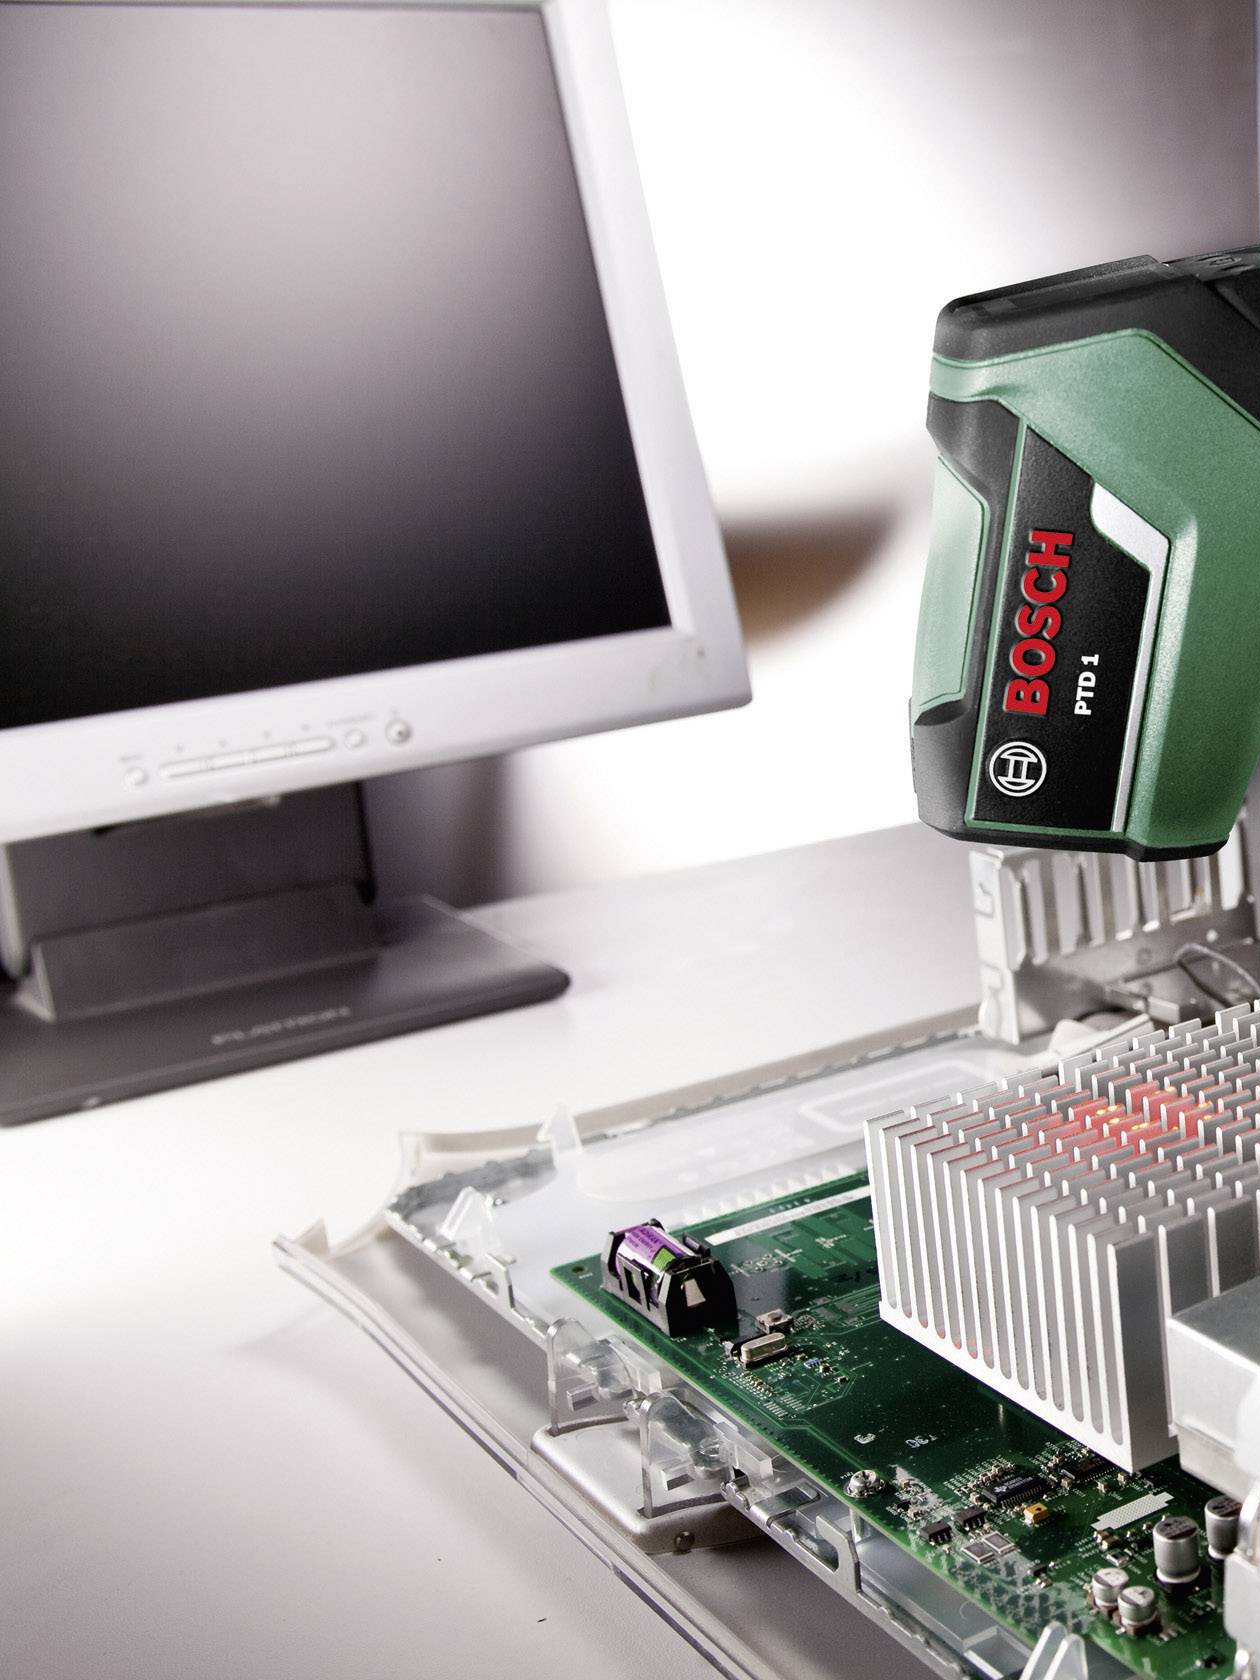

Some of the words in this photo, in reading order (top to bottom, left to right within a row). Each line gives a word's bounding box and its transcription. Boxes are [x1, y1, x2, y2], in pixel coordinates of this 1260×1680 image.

[1003, 529, 1073, 716] BOSCH
[1081, 654, 1099, 666] 1
[1074, 671, 1097, 715] PTD
